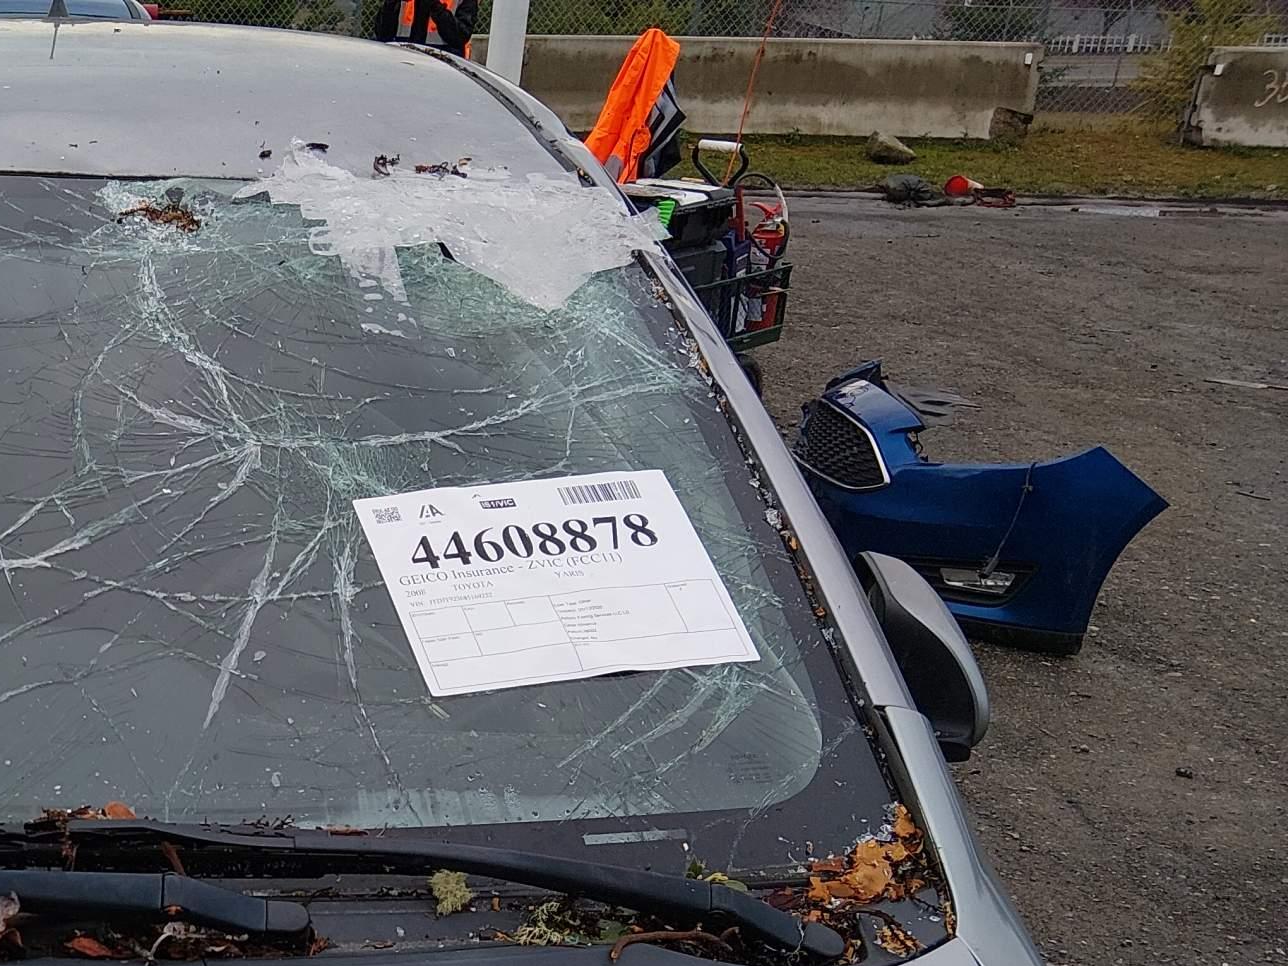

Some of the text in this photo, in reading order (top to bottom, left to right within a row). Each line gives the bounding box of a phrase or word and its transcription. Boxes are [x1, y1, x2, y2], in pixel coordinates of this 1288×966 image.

[411, 512, 659, 569] 44608878
[399, 571, 448, 586] GEICO
[451, 564, 516, 579] Insurance
[527, 558, 563, 570] ZVIC
[567, 551, 623, 568] (FCC11)
[453, 580, 494, 591] TOYOTA
[554, 570, 585, 578] YARIS
